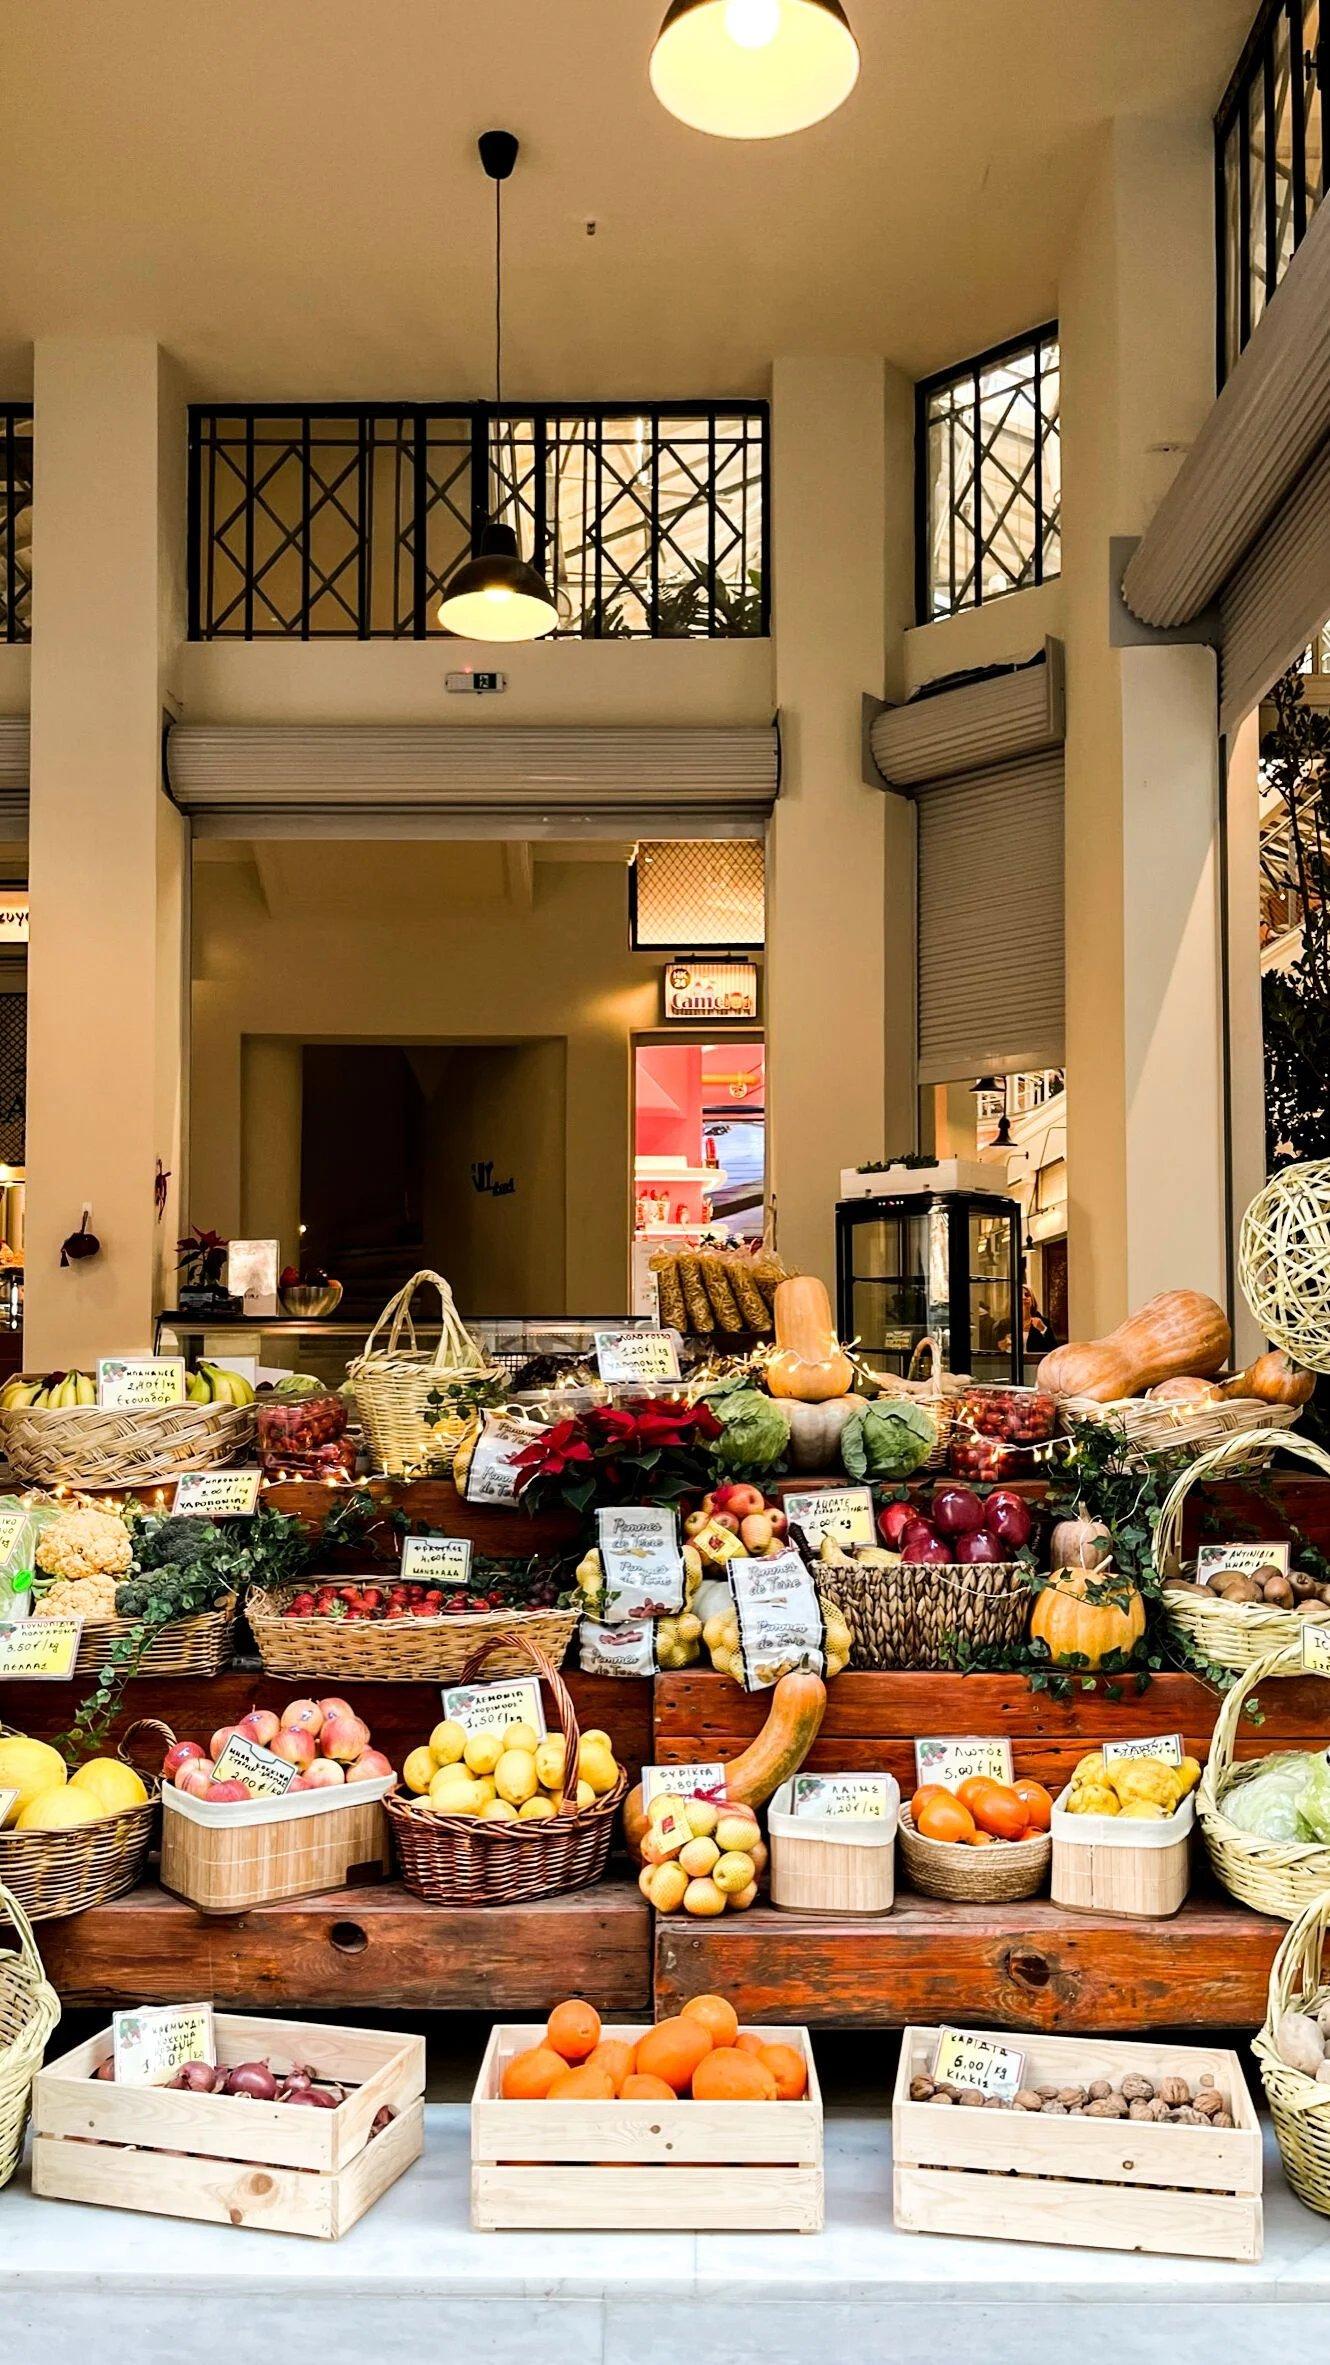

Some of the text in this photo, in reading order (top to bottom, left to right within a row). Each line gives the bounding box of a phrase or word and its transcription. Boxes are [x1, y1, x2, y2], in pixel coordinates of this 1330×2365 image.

[613, 1517, 663, 1534] Pommes
[620, 1561, 669, 1576] Pommes
[748, 1561, 799, 1580] Pommes
[756, 1620, 808, 1635] Pommes
